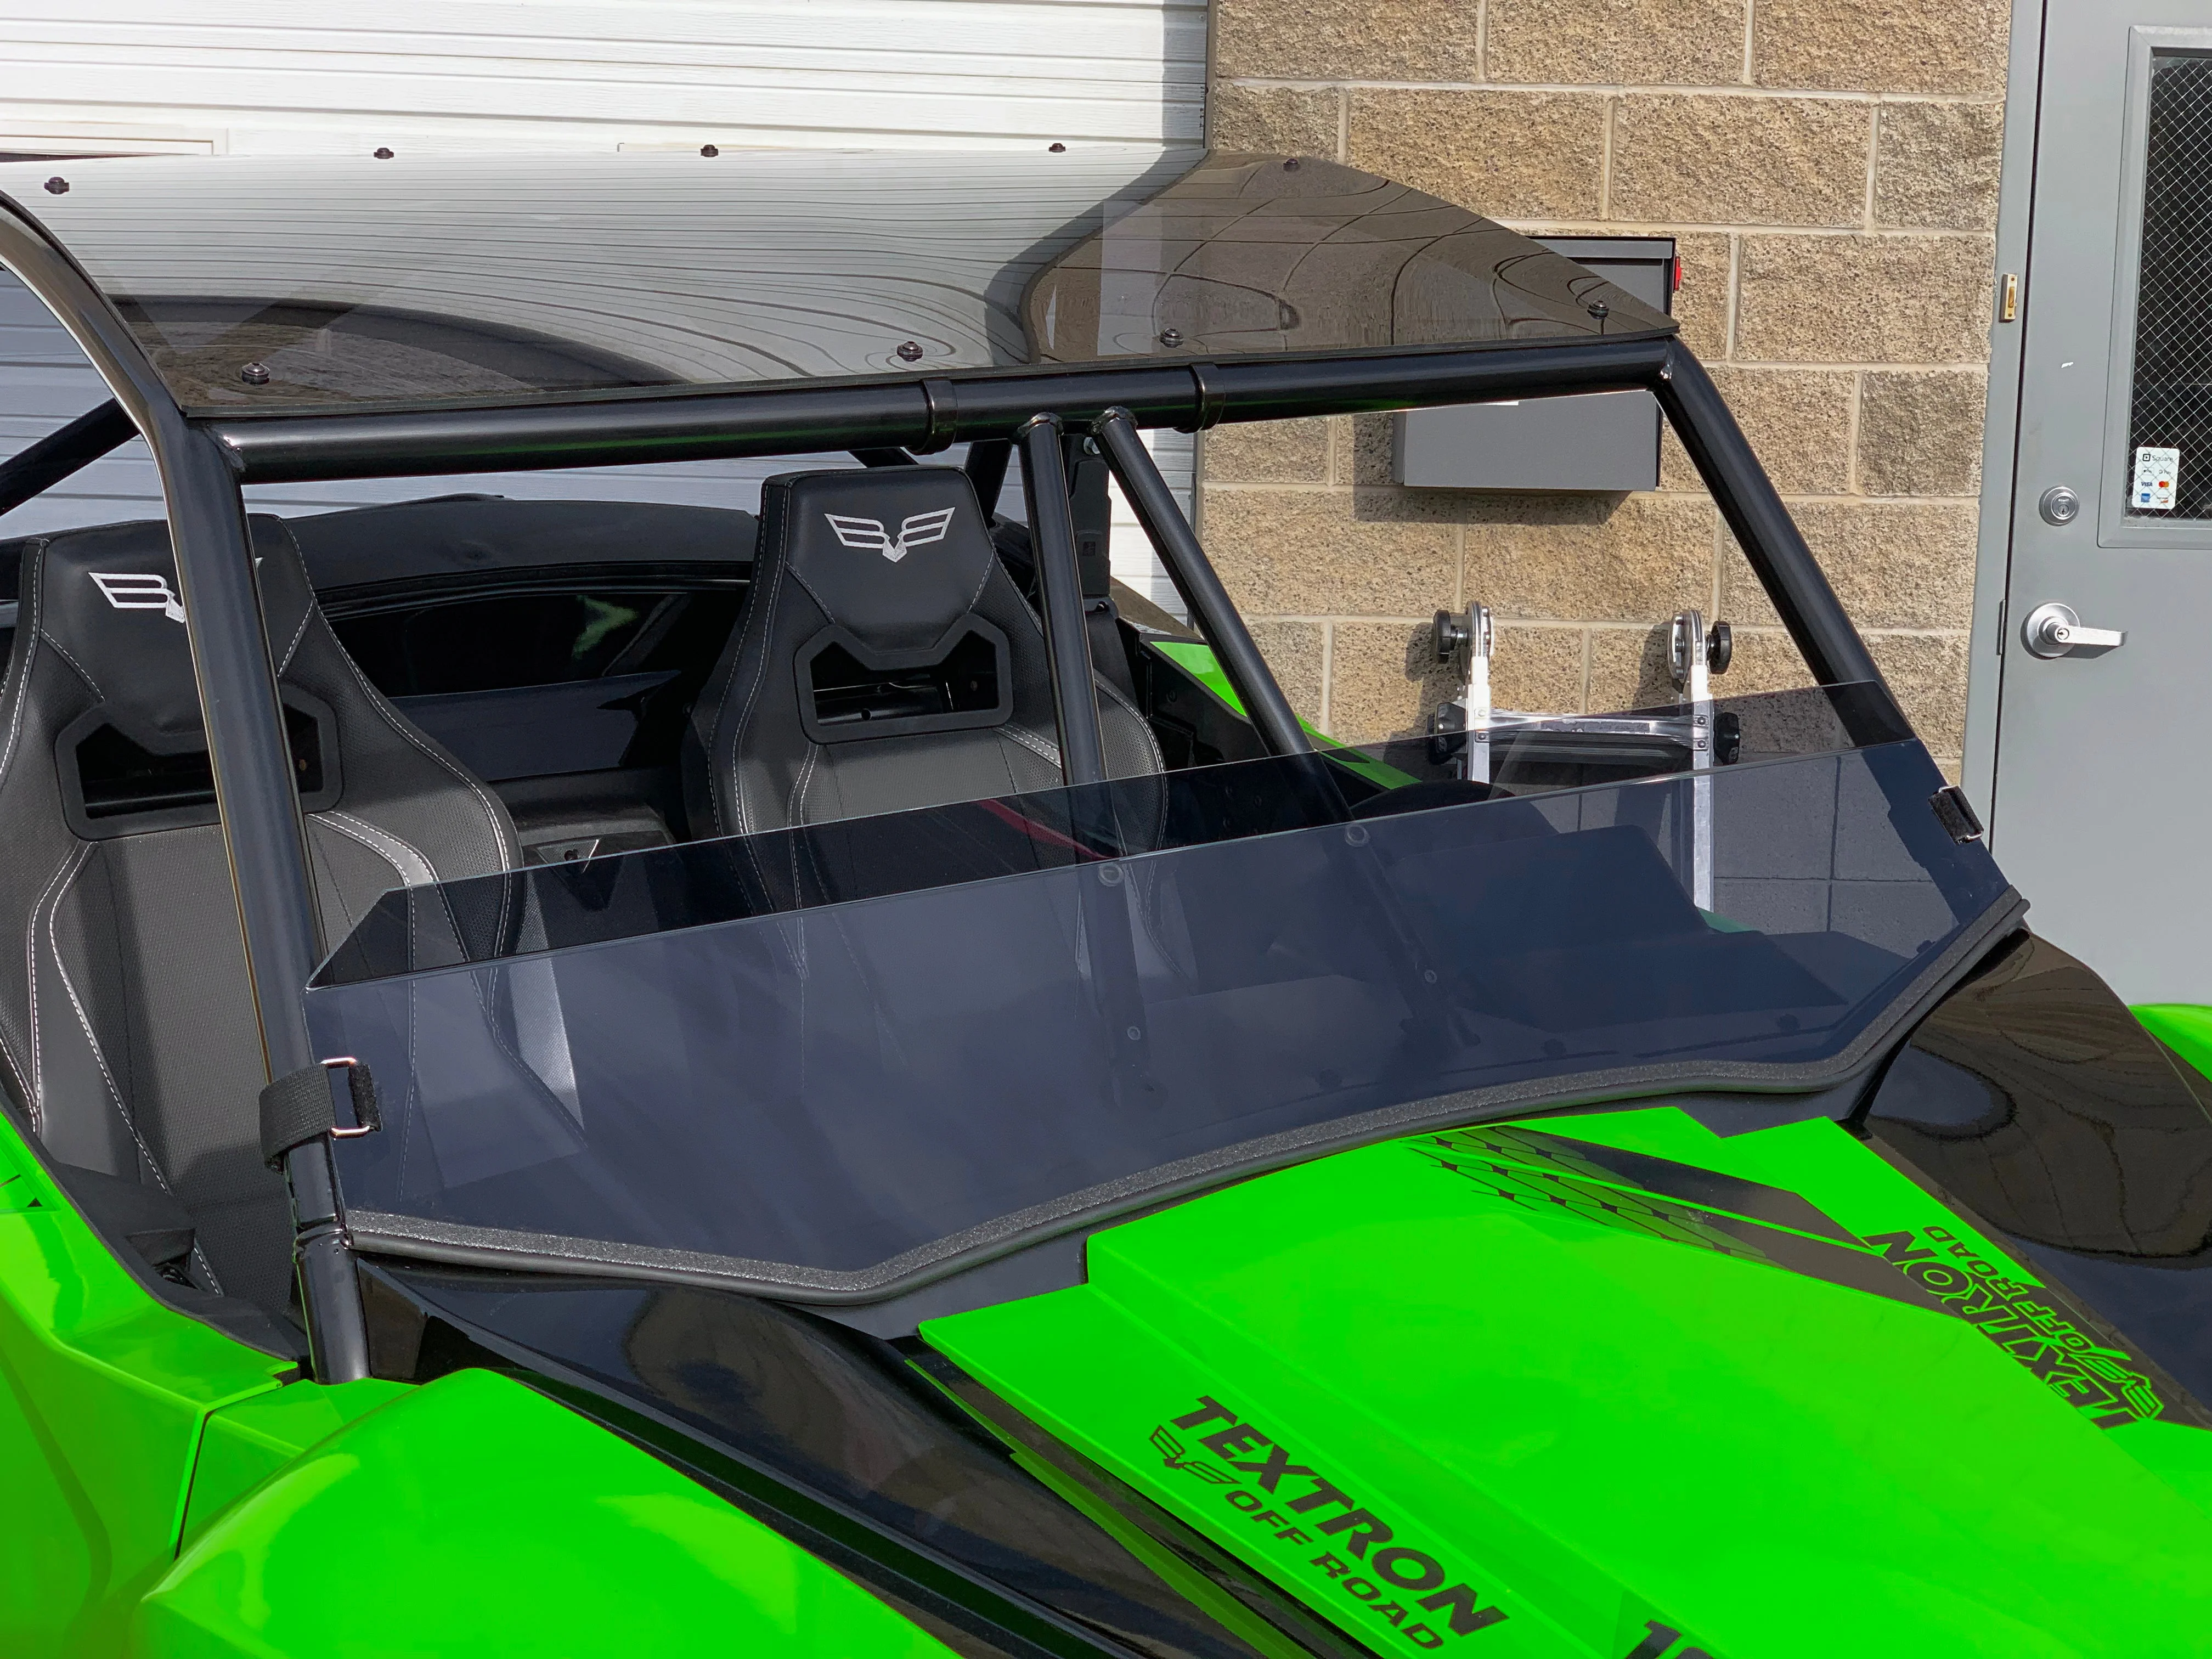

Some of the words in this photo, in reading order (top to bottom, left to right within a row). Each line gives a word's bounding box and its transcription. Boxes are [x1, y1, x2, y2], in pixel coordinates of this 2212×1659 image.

[1922, 1226, 2030, 1301] ROAD
[2012, 1300, 2095, 1353] OFF
[1170, 1395, 1509, 1637] TEXTRON
[1224, 1489, 1314, 1545] OFF
[1309, 1551, 1444, 1649] ROAD
